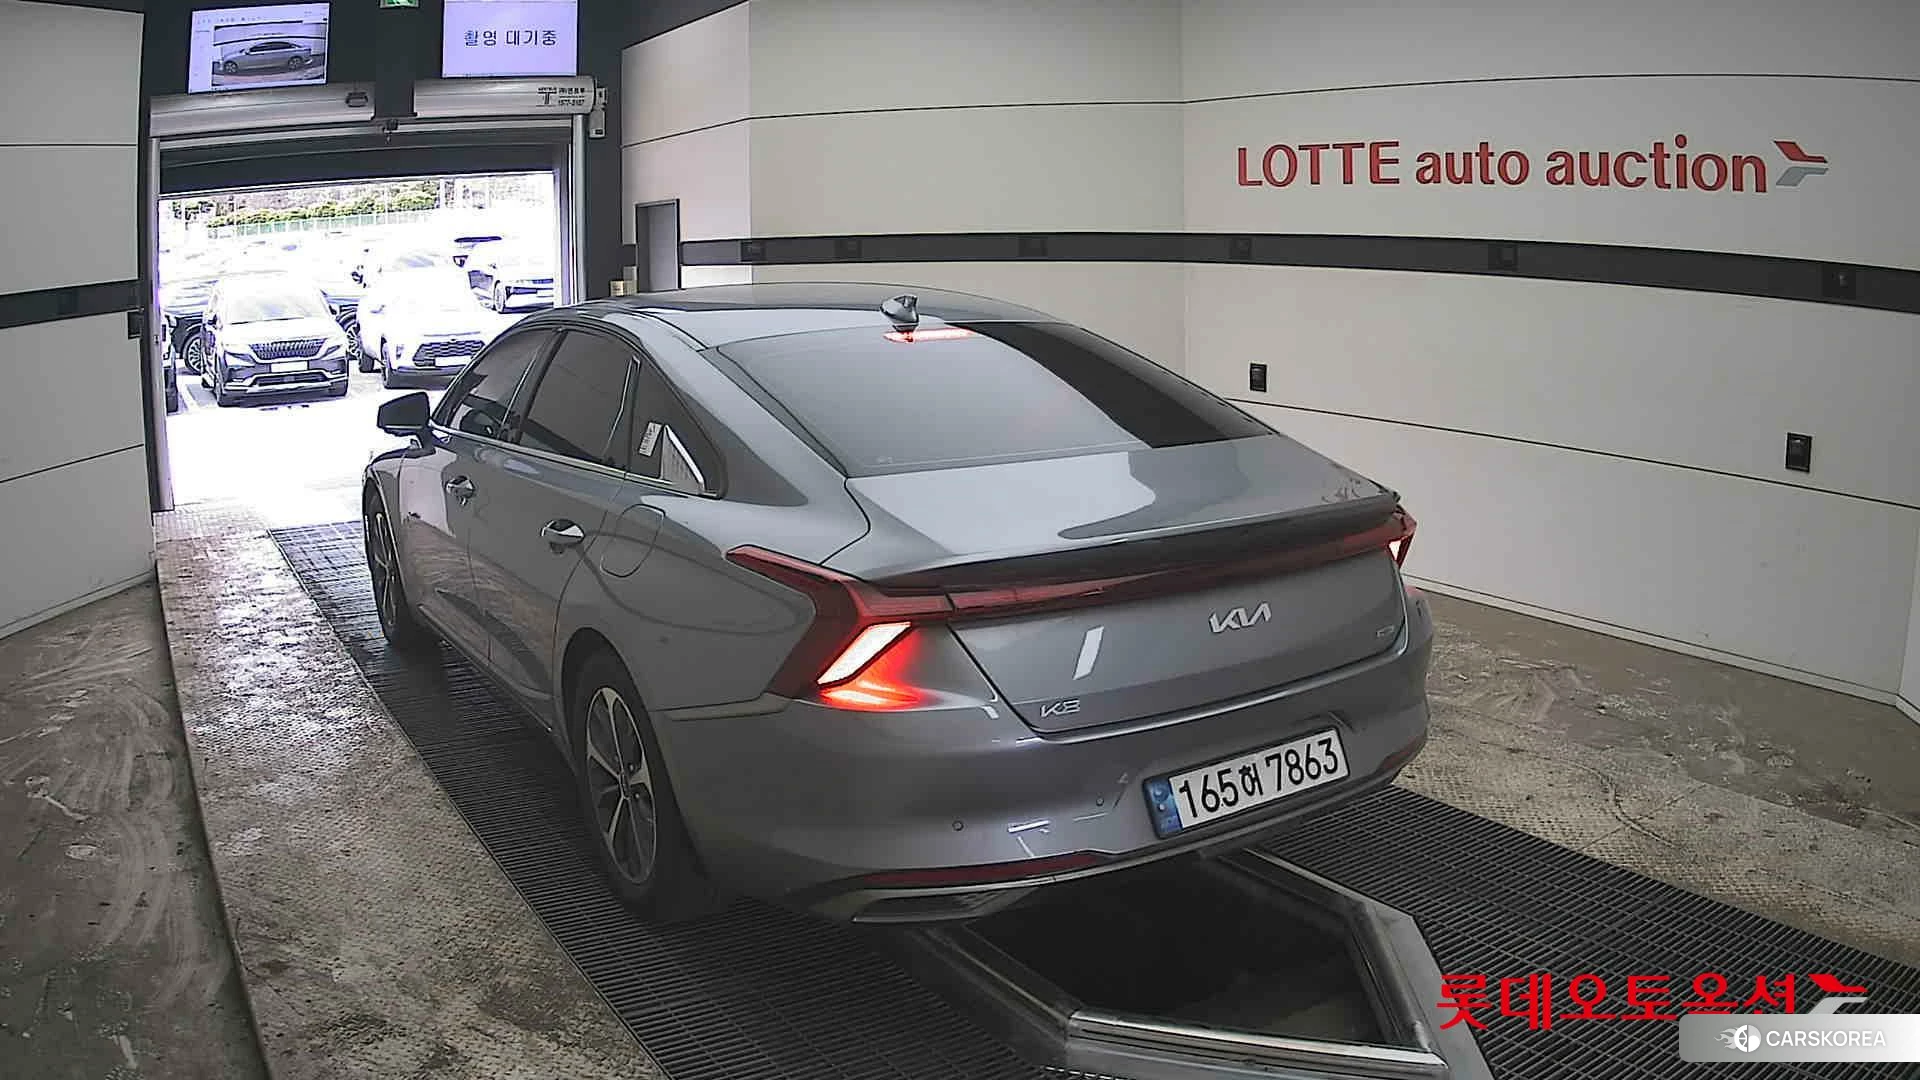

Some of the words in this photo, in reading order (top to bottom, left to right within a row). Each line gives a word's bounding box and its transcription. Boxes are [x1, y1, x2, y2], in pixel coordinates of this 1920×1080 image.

[505, 29, 557, 46] 대기중
[1237, 140, 1400, 187] LOTTE
[1415, 141, 1530, 186] auto
[1545, 134, 1768, 194] auction
[1208, 602, 1272, 634] KIA
[1040, 699, 1081, 718] K8
[1265, 737, 1339, 792] 7863
